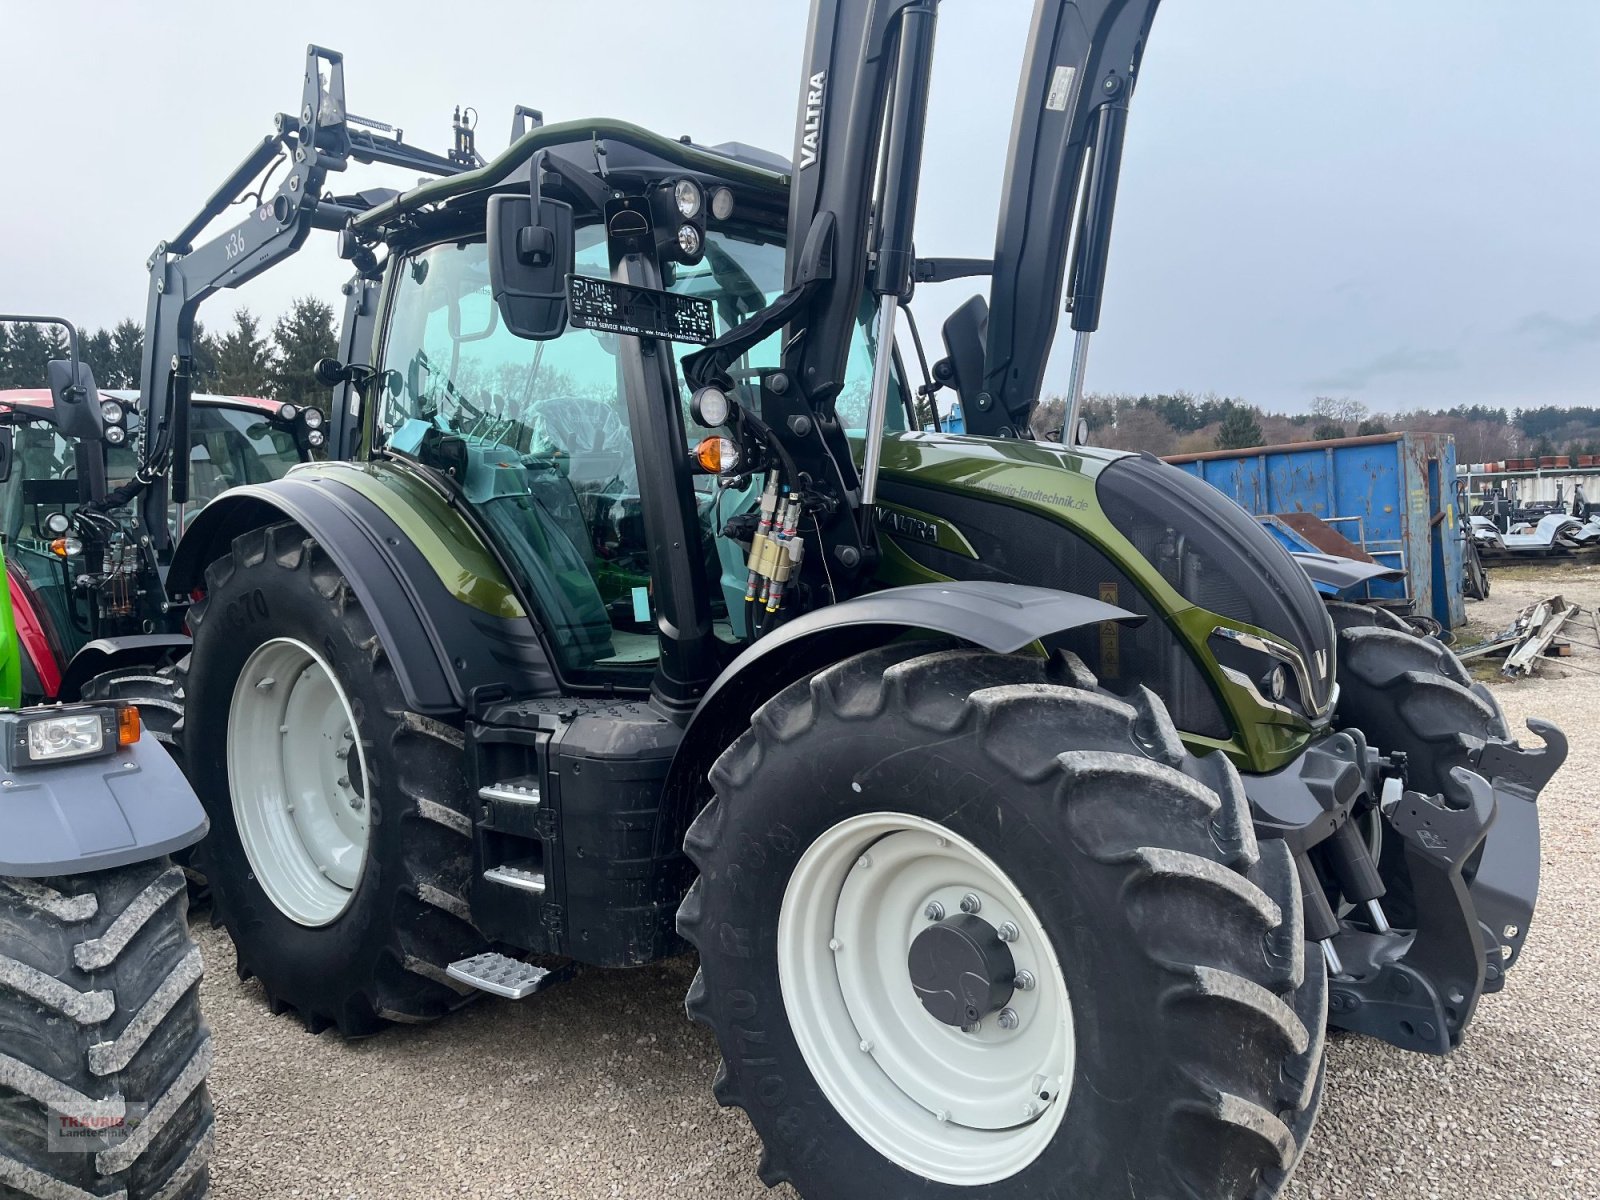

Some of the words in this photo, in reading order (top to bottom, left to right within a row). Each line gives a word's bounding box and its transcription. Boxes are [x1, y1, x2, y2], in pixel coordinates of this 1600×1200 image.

[800, 71, 825, 169] VALTRA
[599, 322, 618, 331] SERVICE
[620, 325, 639, 334] PARTNER
[964, 479, 1089, 511] www.traurig-landtechnik.de
[875, 507, 938, 542] VALTRA
